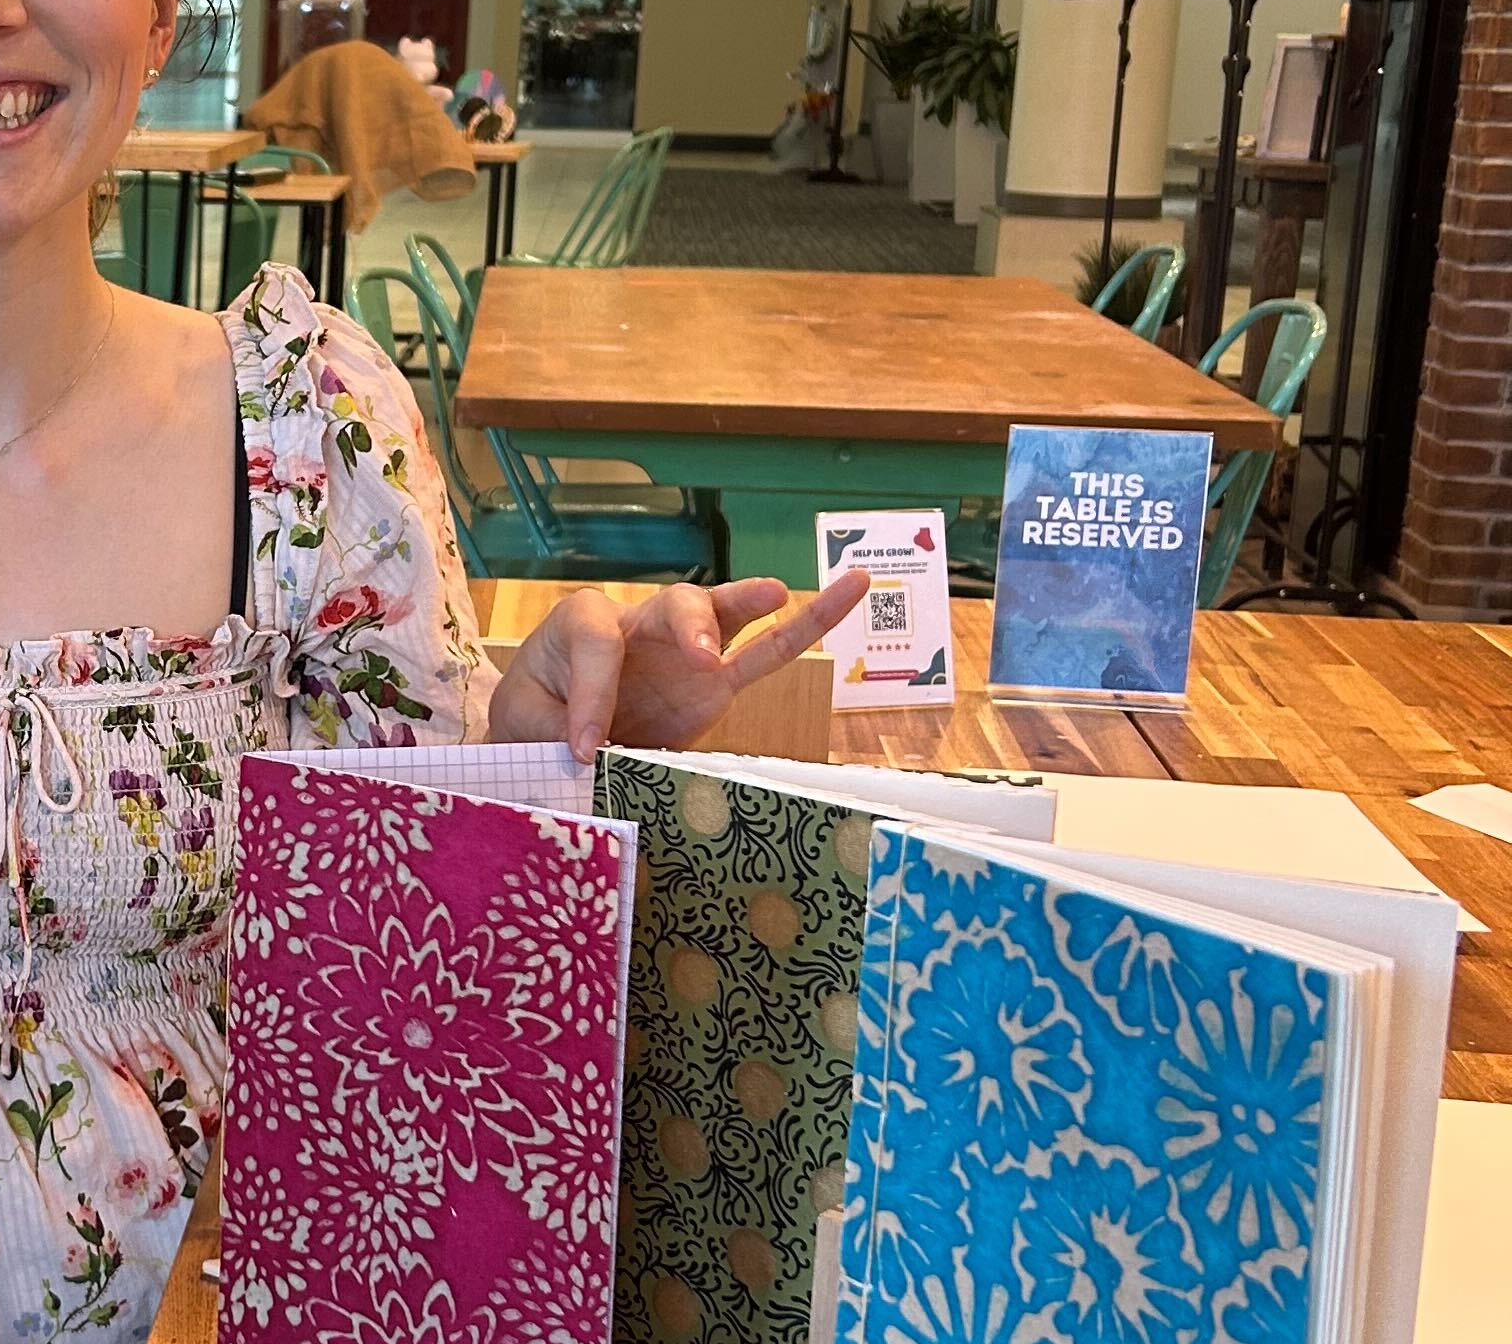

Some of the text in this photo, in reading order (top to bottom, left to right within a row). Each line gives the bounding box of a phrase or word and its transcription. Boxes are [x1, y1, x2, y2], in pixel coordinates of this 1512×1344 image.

[1070, 472, 1144, 498] THIS
[1036, 496, 1174, 524] TABLE IS
[1022, 521, 1184, 550] RESERVED
[852, 549, 872, 558] HELP
[874, 549, 884, 557] US
